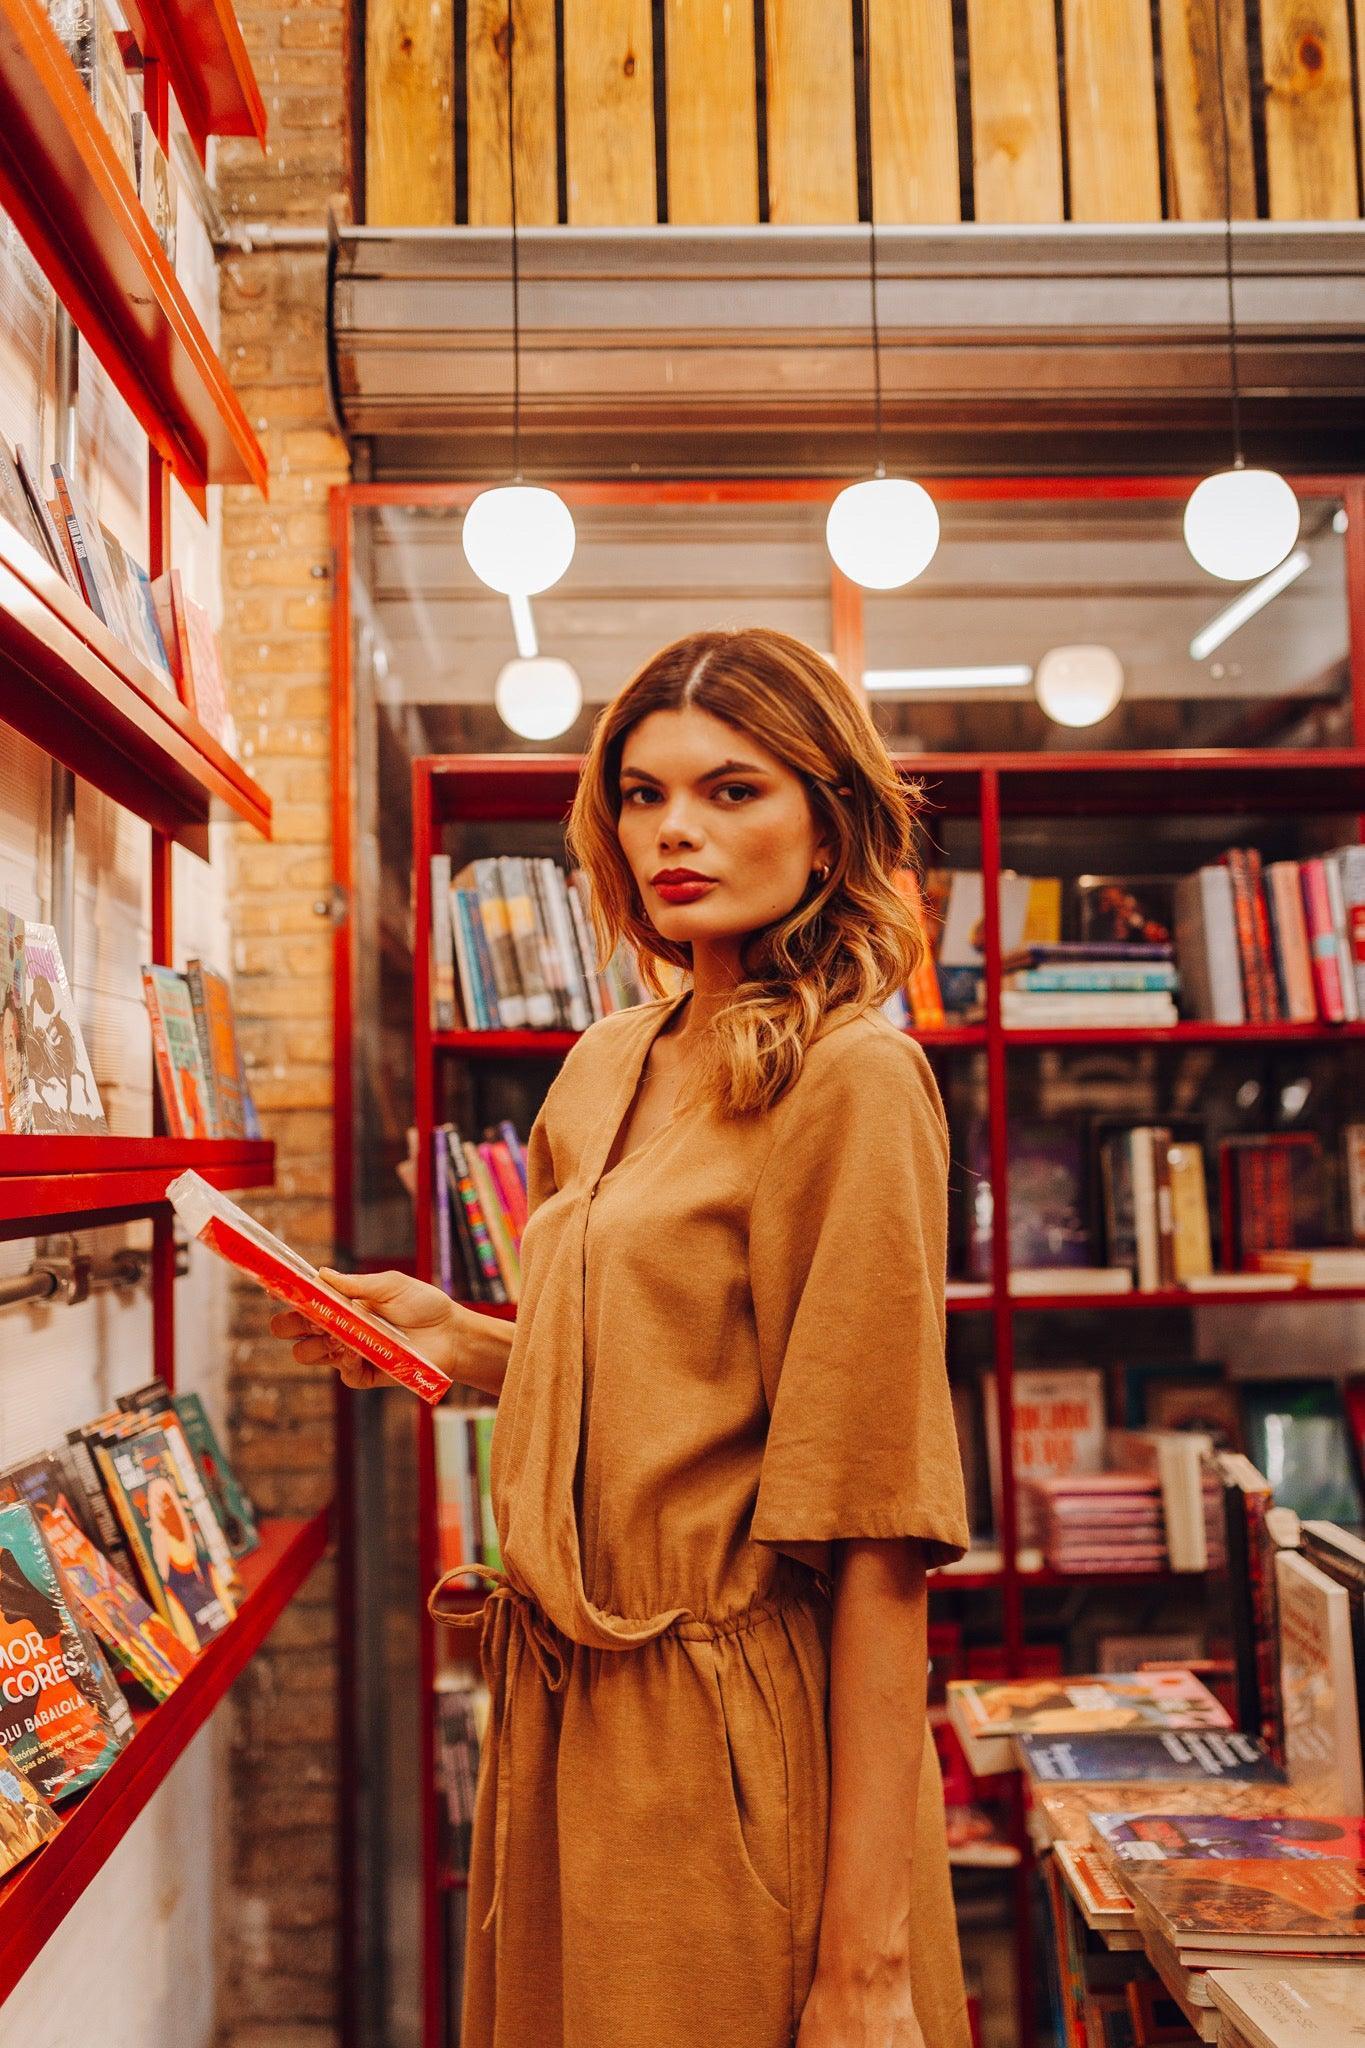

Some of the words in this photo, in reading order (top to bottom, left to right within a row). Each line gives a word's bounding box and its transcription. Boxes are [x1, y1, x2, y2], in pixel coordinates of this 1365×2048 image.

[310, 1297, 355, 1334] MARGARET
[356, 1330, 394, 1361] ATWOOD
[2, 1651, 80, 1704] CORES
[23, 1693, 85, 1733] BABALOLA
[36, 1755, 47, 1764] ao
[46, 1745, 65, 1759] redor
[64, 1739, 75, 1749] do
[37, 1729, 71, 1751] inspiradas
